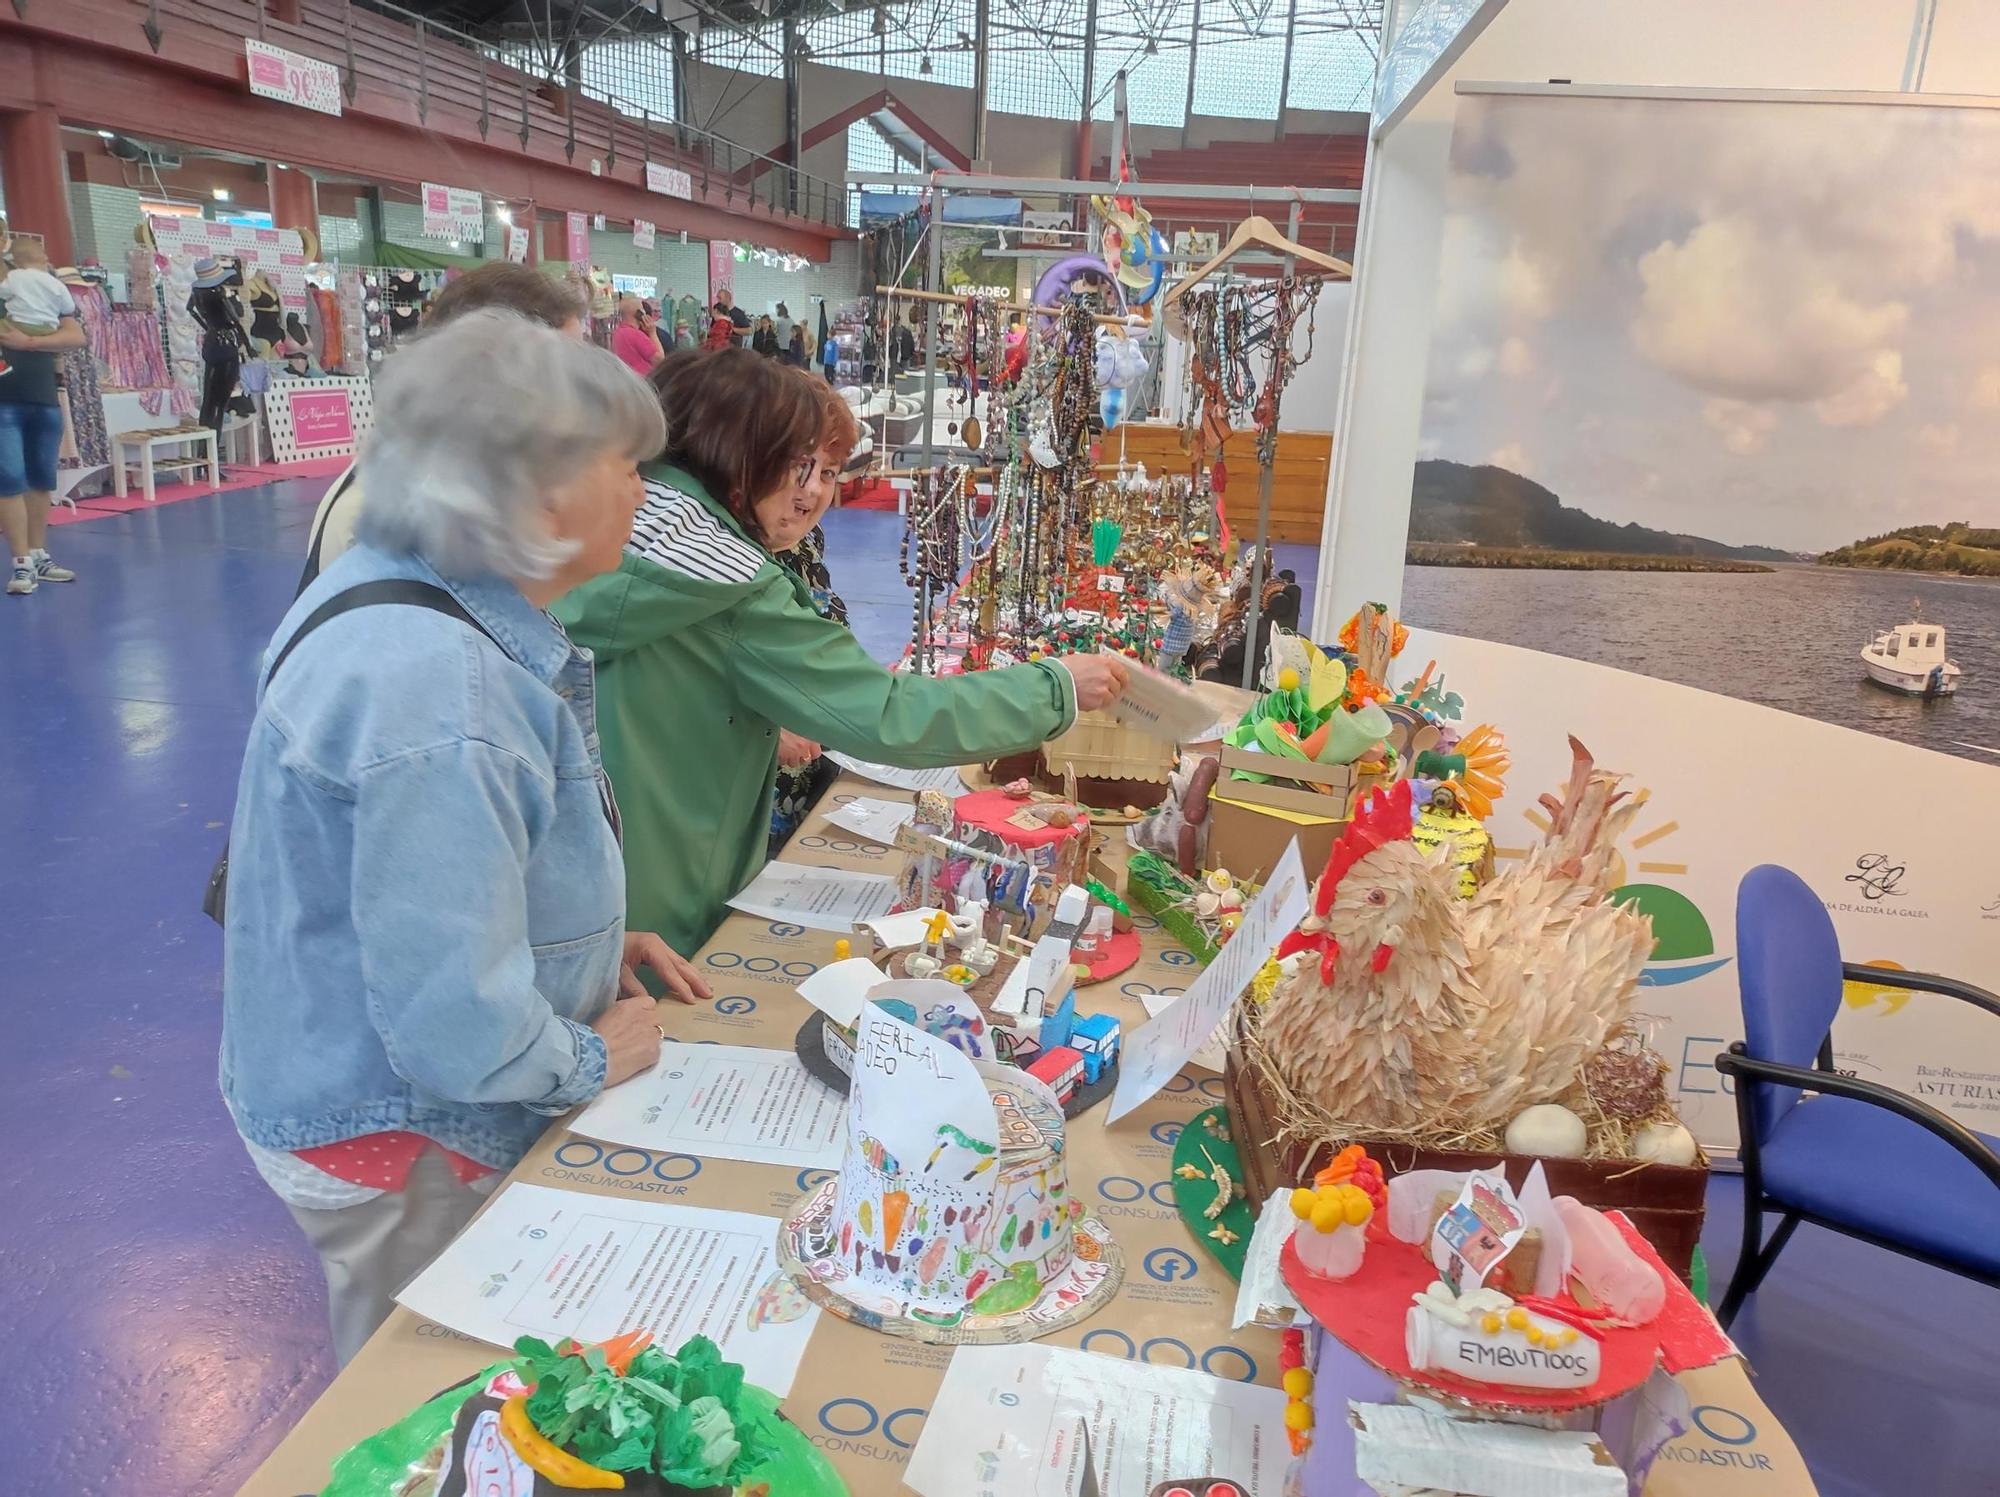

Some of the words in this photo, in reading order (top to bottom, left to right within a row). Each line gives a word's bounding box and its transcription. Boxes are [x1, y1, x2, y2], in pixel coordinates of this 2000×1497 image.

[952, 285, 1010, 298] VEGADEO
[1840, 903, 1851, 911] DE
[1854, 905, 1884, 914] ALDEA
[1899, 909, 1929, 919] GALEA
[700, 967, 806, 986] CONSUMOASTU
[859, 1038, 898, 1075] ADEO
[870, 1021, 955, 1080] FERIAL
[541, 1167, 688, 1196] CONSUMOASTUR
[1097, 1204, 1181, 1221] CONSUM
[880, 1342, 918, 1353] CENTROS
[890, 1350, 914, 1359] PARA
[810, 1434, 911, 1464] CONSUM
[1657, 1446, 1773, 1471] MOASTUR
